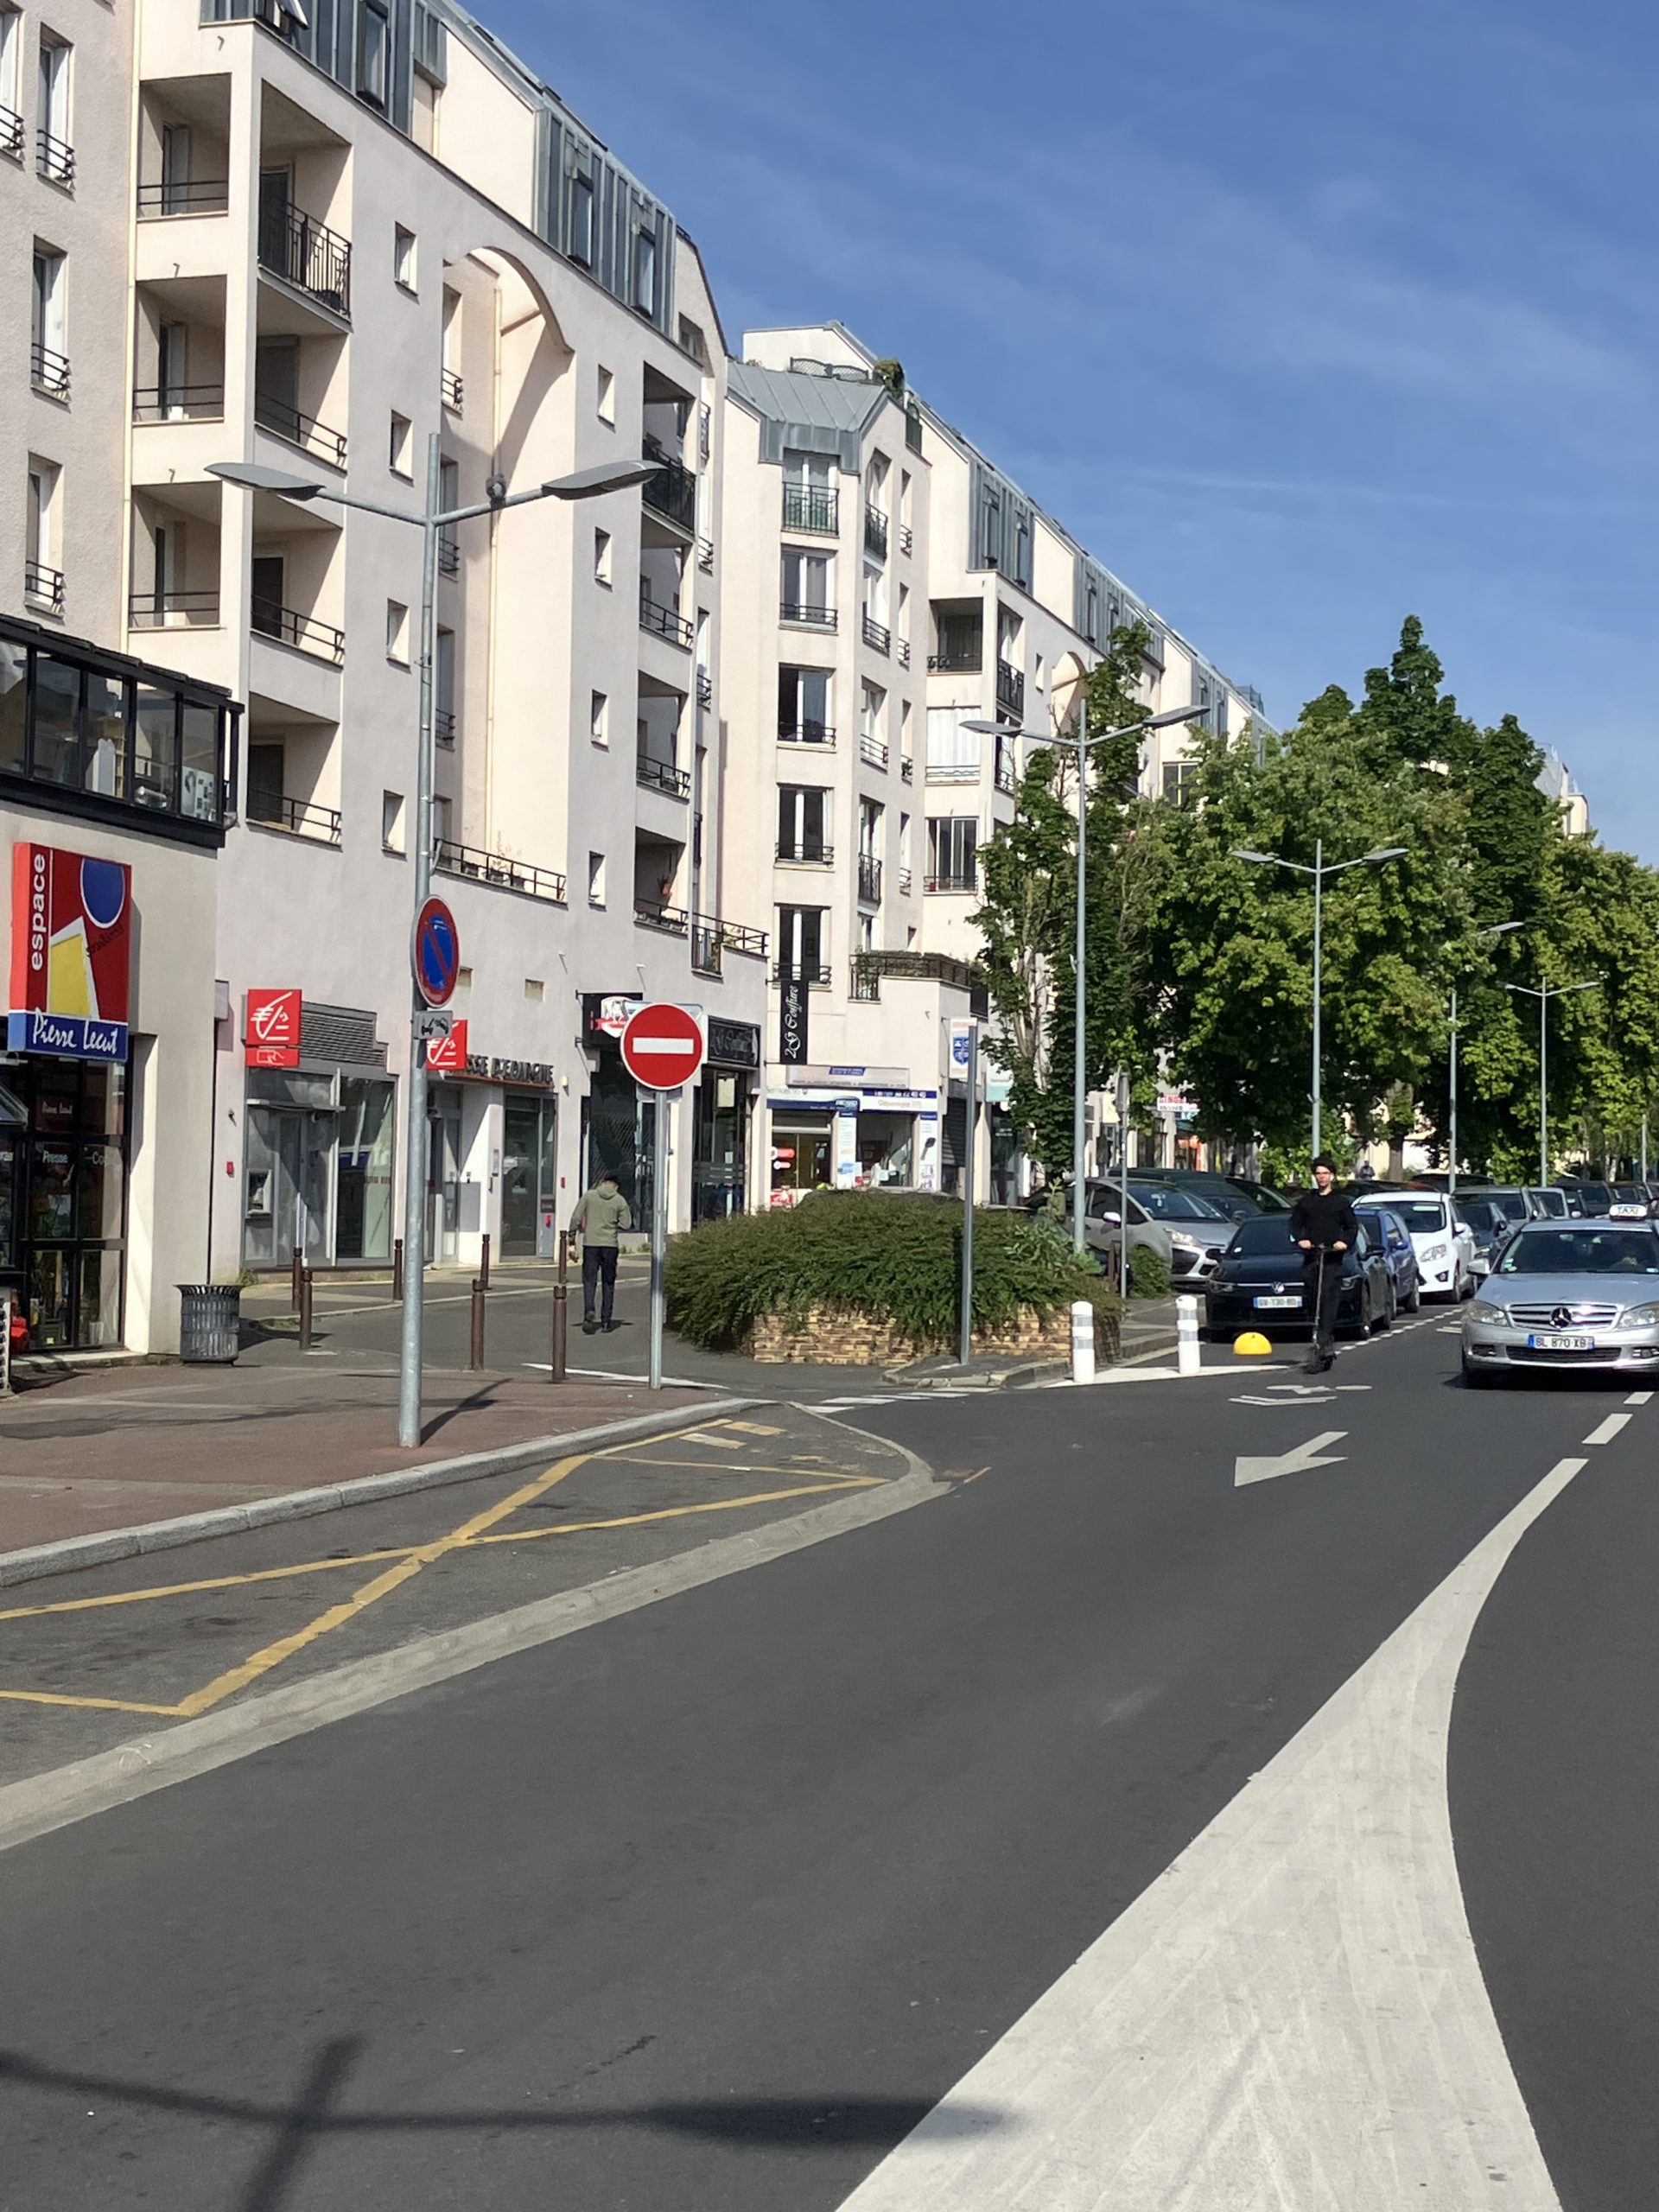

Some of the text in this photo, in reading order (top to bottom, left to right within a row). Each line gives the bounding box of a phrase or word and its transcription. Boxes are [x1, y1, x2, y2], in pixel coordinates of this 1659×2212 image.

[31, 853, 47, 971] espace
[33, 1007, 77, 1048] Pierre
[785, 985, 803, 1029] Coiffure
[467, 1053, 489, 1076] SSE
[1617, 1205, 1639, 1215] TAXI
